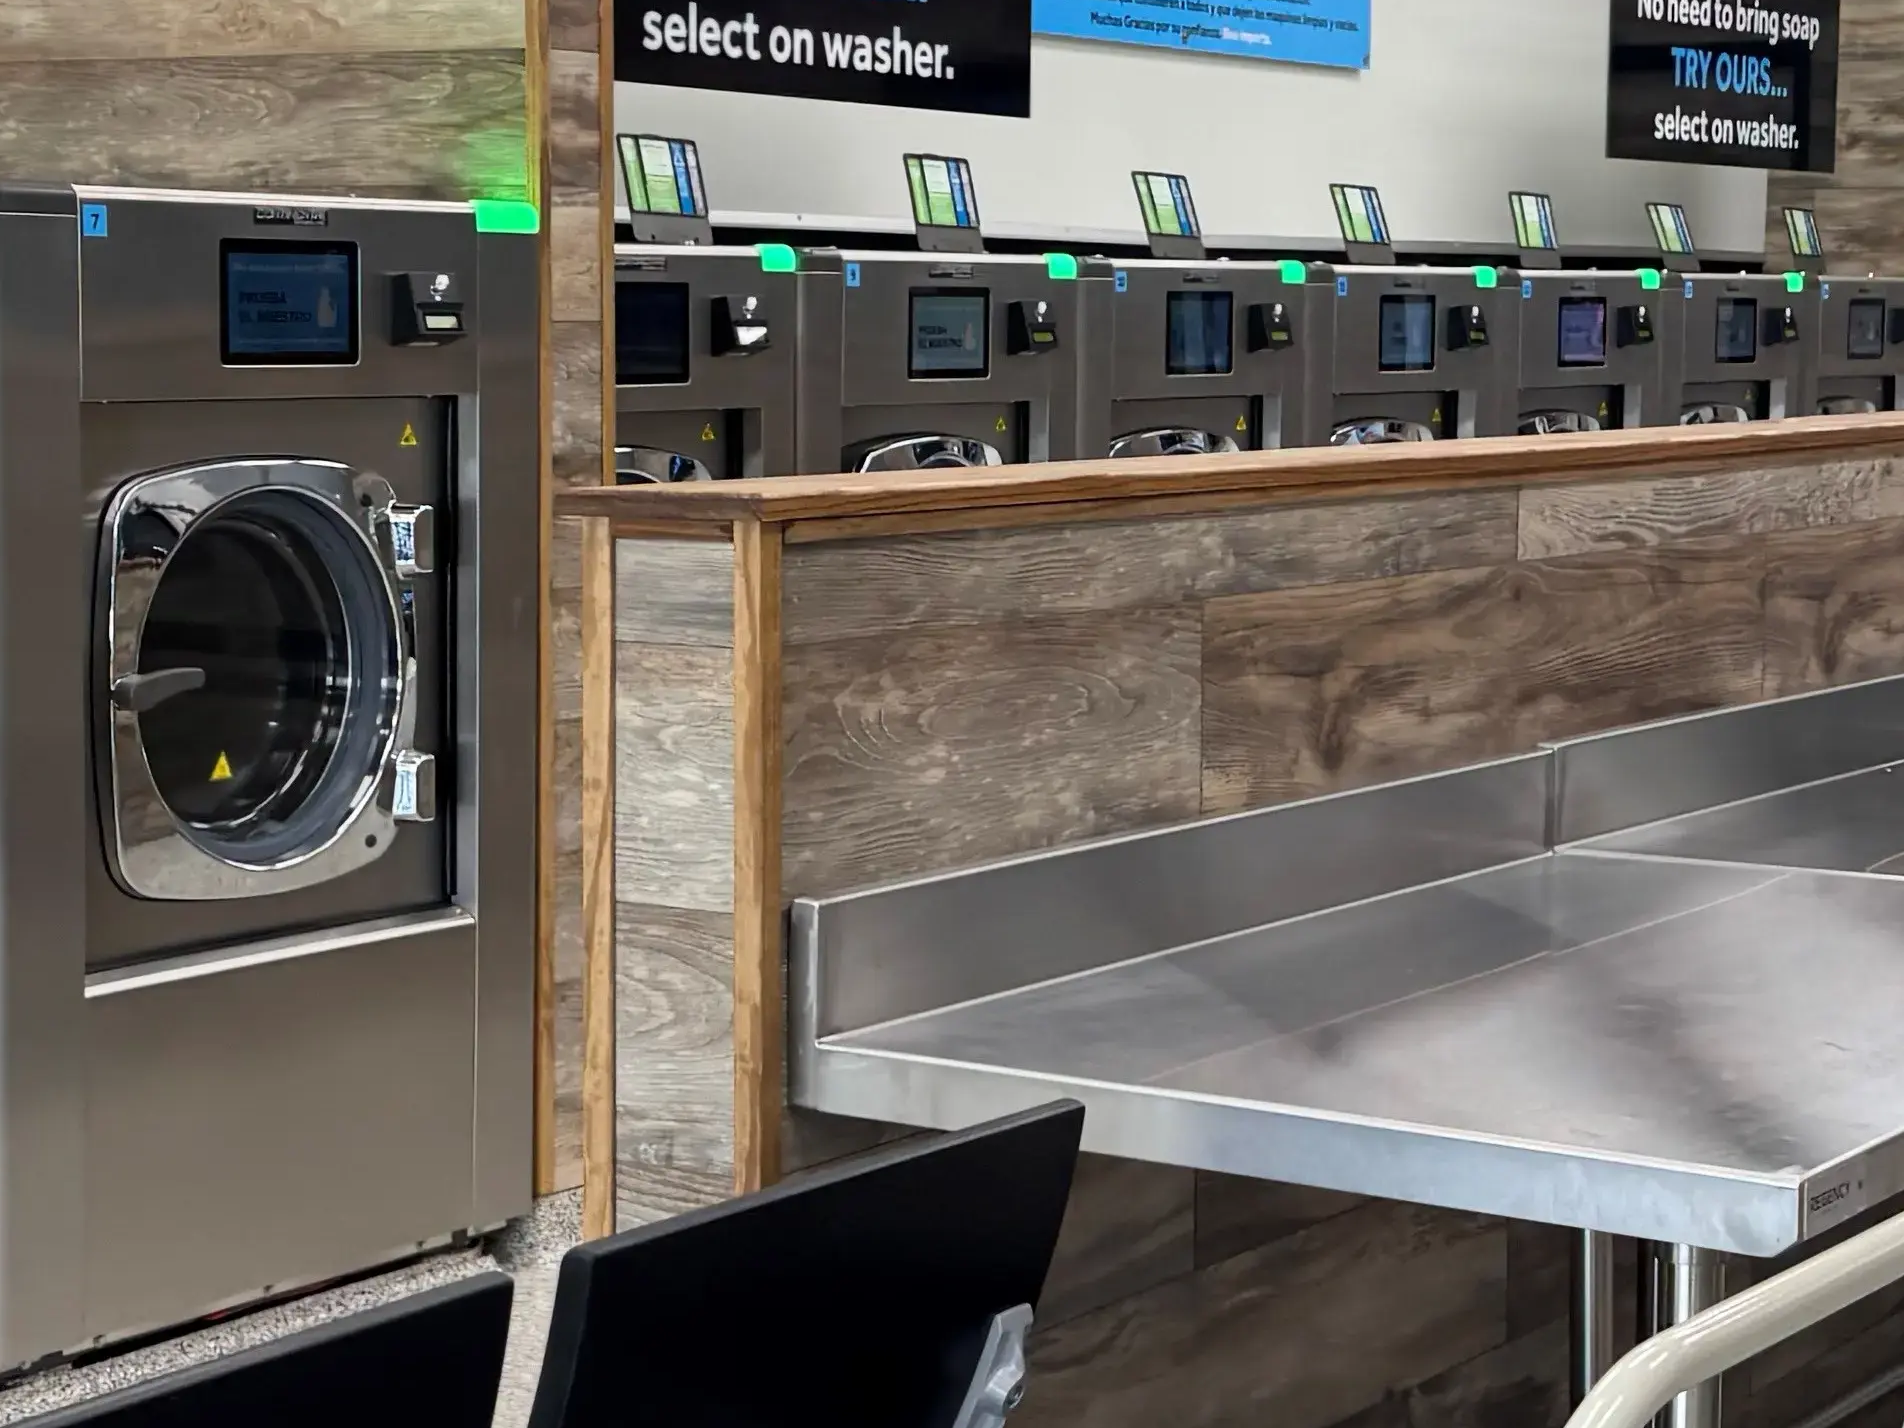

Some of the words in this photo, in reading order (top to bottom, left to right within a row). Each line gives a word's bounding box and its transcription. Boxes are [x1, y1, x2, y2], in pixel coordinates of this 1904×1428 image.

[642, 2, 761, 61] select
[770, 25, 814, 66] on
[823, 27, 954, 79] washer.
[1781, 13, 1820, 50] soap
[1671, 47, 1712, 89] TRY
[1716, 52, 1787, 97] OURS...
[1654, 105, 1708, 143] select
[1712, 118, 1733, 144] on
[1737, 114, 1799, 149] washer.
[90, 213, 100, 229] 7
